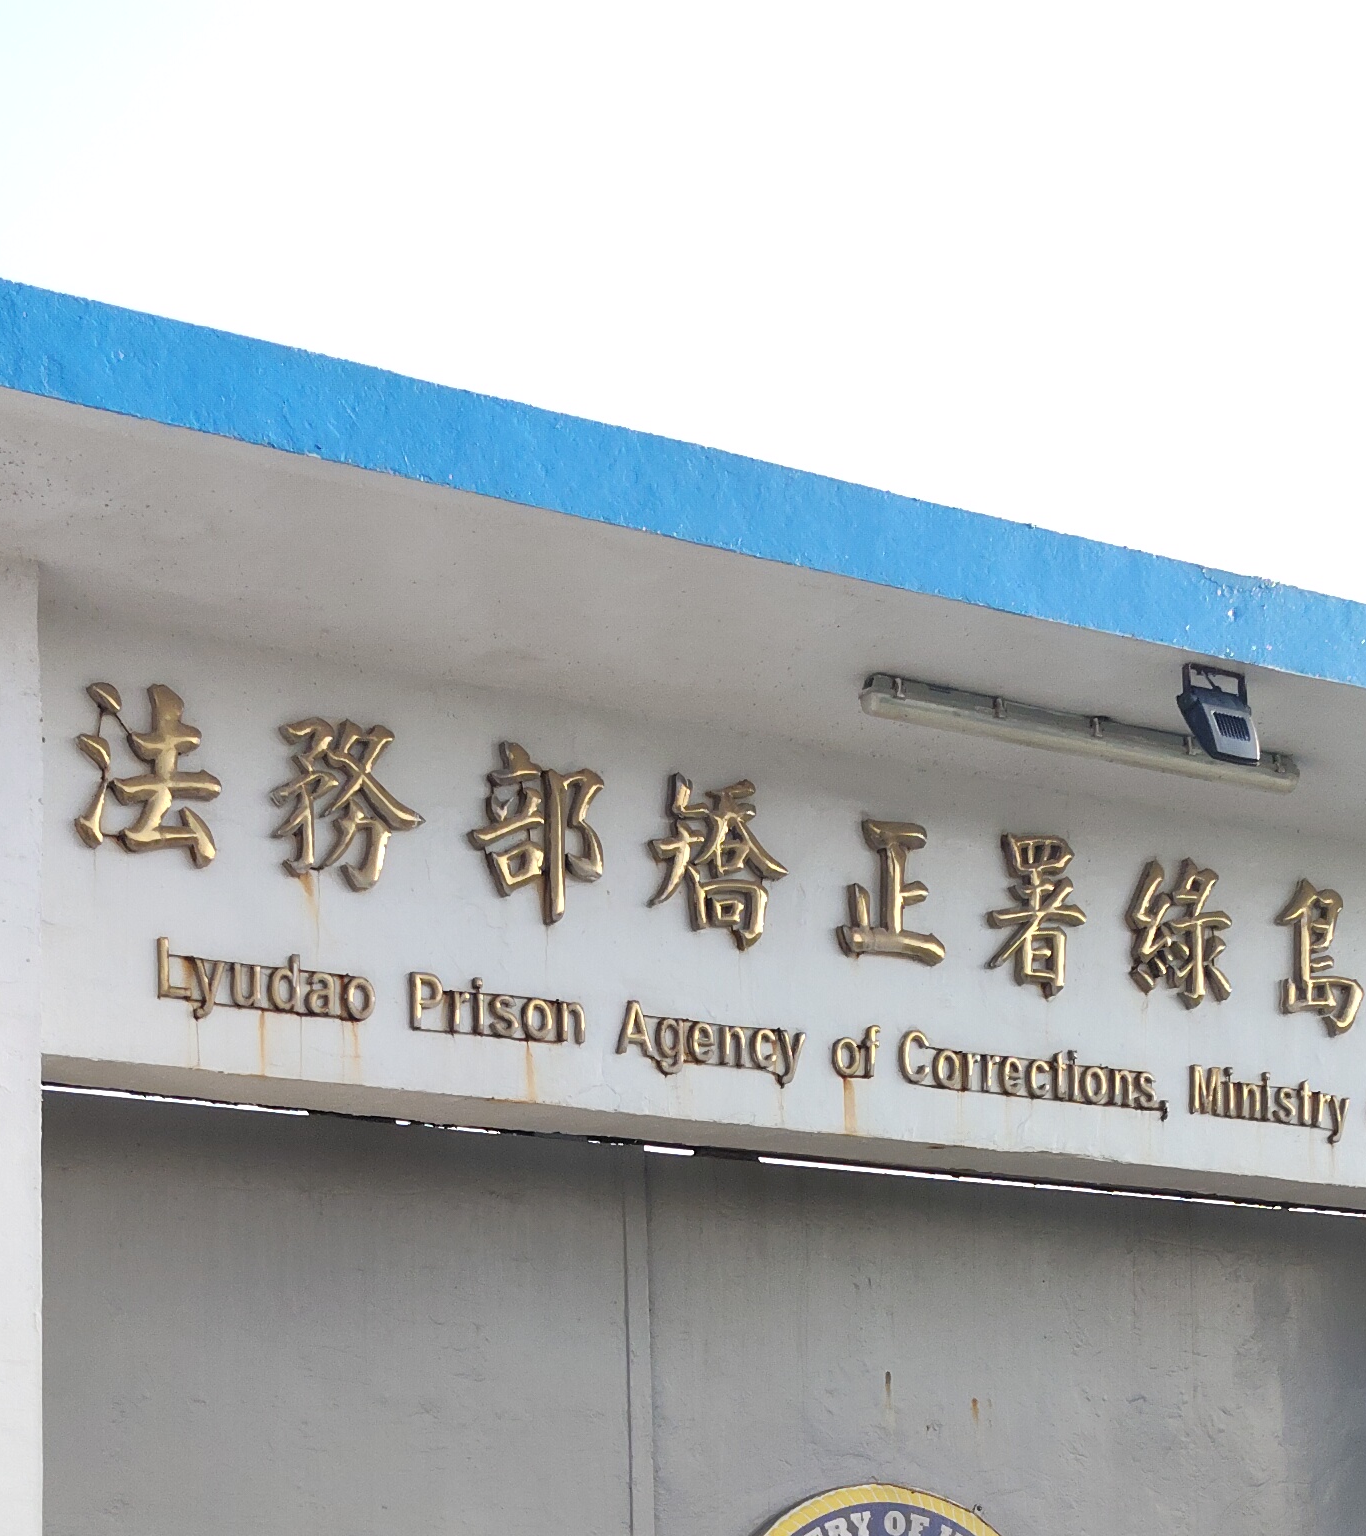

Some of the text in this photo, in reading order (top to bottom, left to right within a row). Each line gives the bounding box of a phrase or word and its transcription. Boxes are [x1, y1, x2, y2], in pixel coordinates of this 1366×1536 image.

[156, 936, 376, 1021] Lyudao
[408, 970, 586, 1044] Prison
[616, 999, 806, 1089] Agency
[832, 1024, 881, 1080] of
[899, 1029, 1168, 1122] Corrections,
[1188, 1063, 1350, 1145] Ministry
